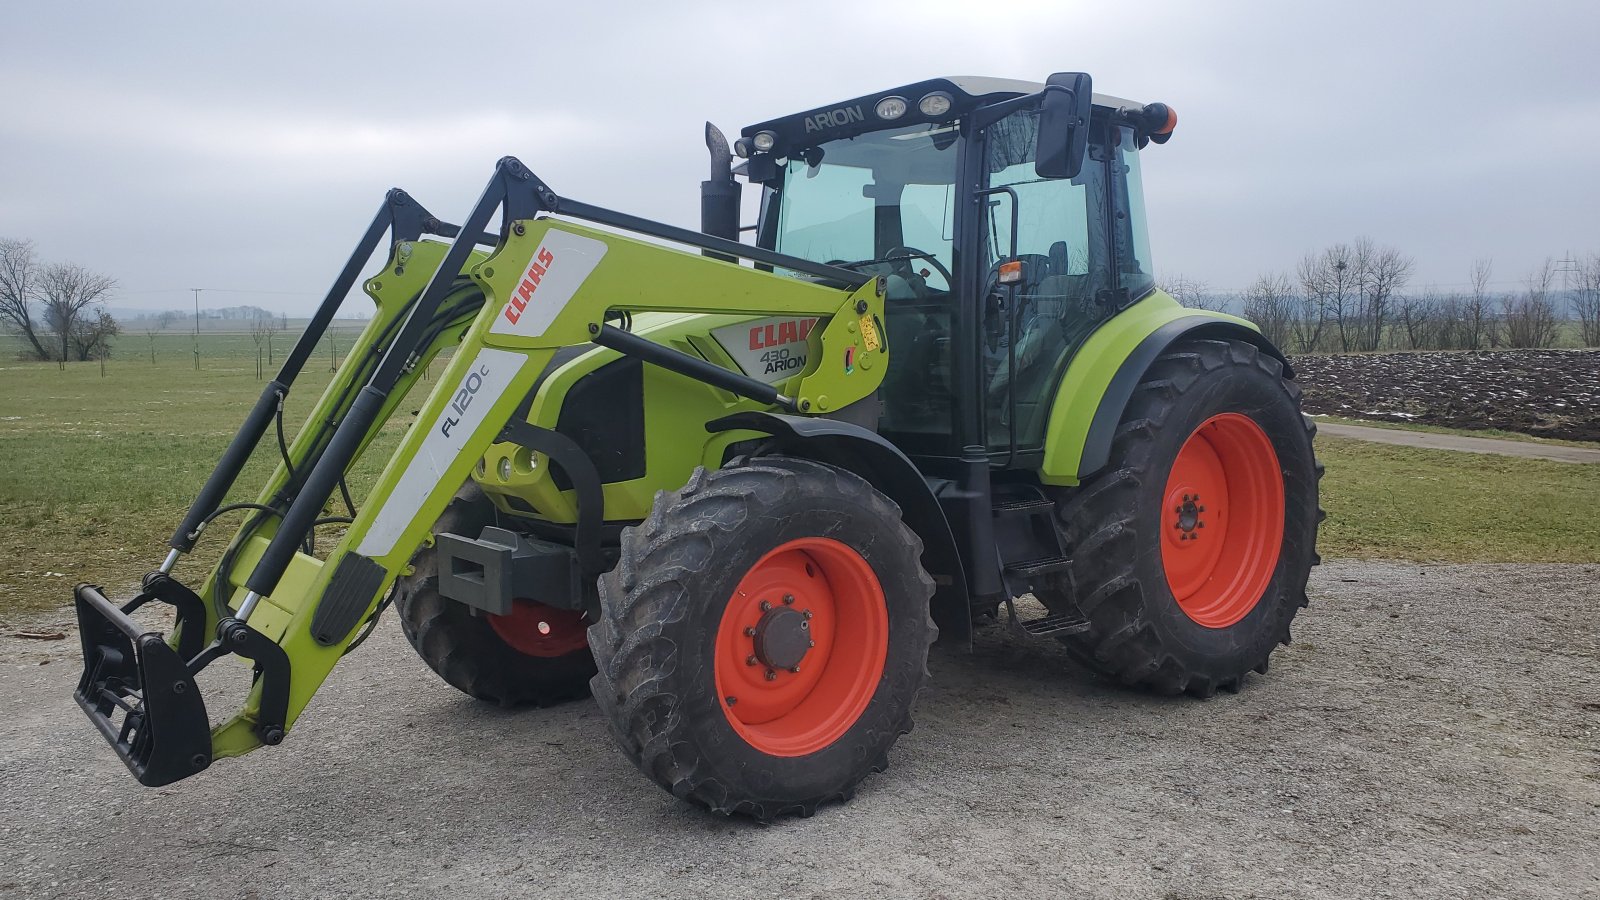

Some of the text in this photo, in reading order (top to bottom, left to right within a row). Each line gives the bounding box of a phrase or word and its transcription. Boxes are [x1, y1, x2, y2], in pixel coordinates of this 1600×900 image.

[805, 105, 865, 133] ARION
[504, 246, 554, 325] CLAAS
[749, 318, 817, 351] CLAA
[760, 348, 790, 363] 430
[764, 356, 807, 375] ARION
